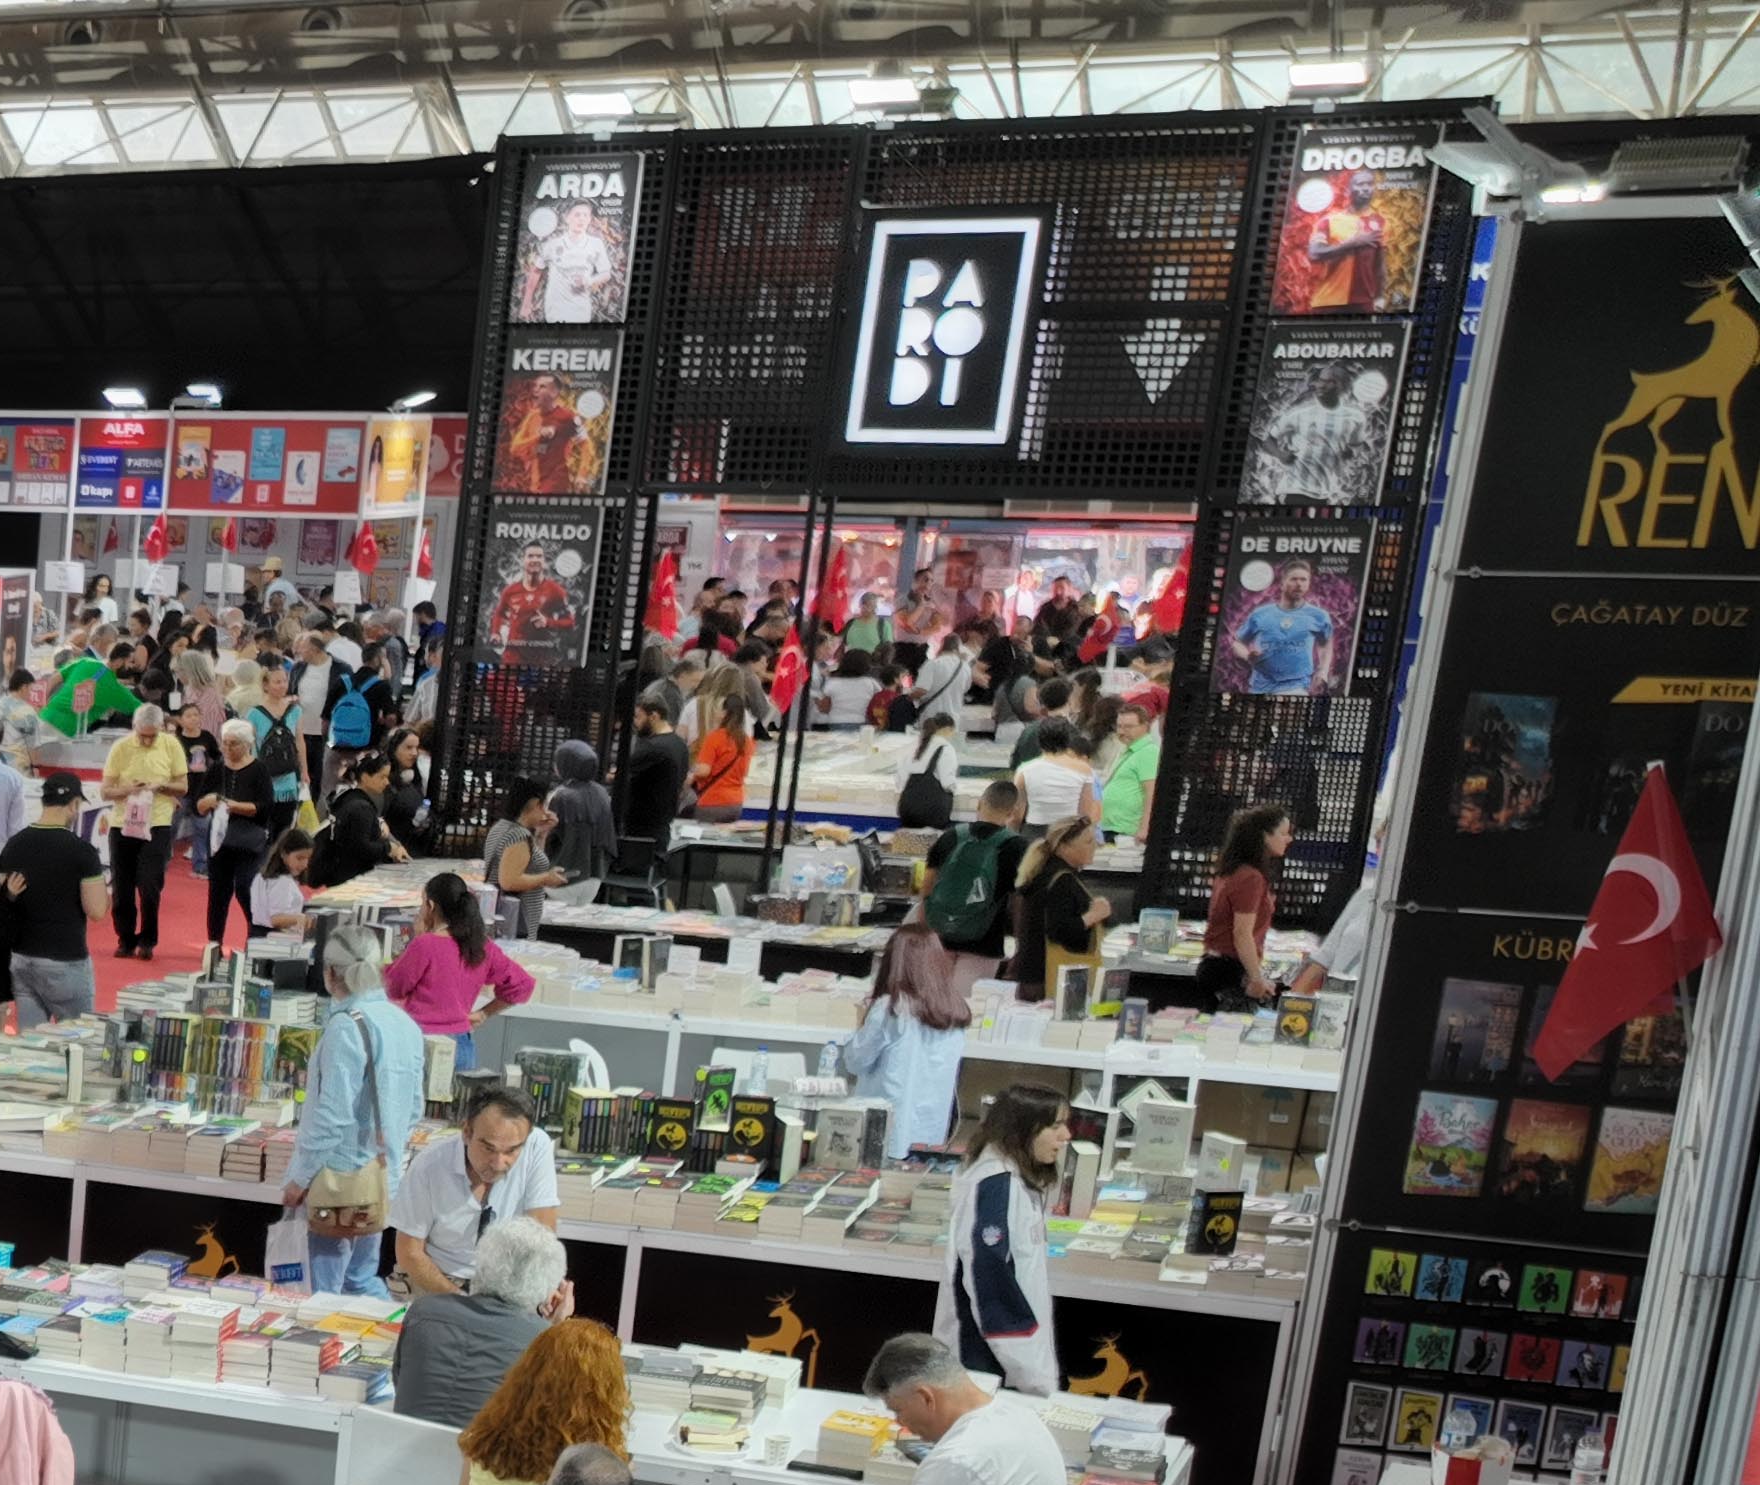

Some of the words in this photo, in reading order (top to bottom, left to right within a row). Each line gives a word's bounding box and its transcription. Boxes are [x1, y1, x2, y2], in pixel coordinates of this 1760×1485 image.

[1301, 145, 1427, 172] DROGBA
[536, 173, 625, 199] ARDA
[511, 348, 611, 372] KEREM
[1272, 342, 1395, 360] ABOUBAKAR
[103, 422, 145, 436] ALFA
[495, 521, 592, 542] RONALDO
[1241, 536, 1270, 553] DE
[1275, 536, 1363, 554] BRUYNE
[1550, 599, 1682, 628] ÇAĞATAY
[1660, 679, 1704, 698] YENİ
[1710, 679, 1757, 699] KİTA
[1493, 929, 1575, 961] KÜBR
